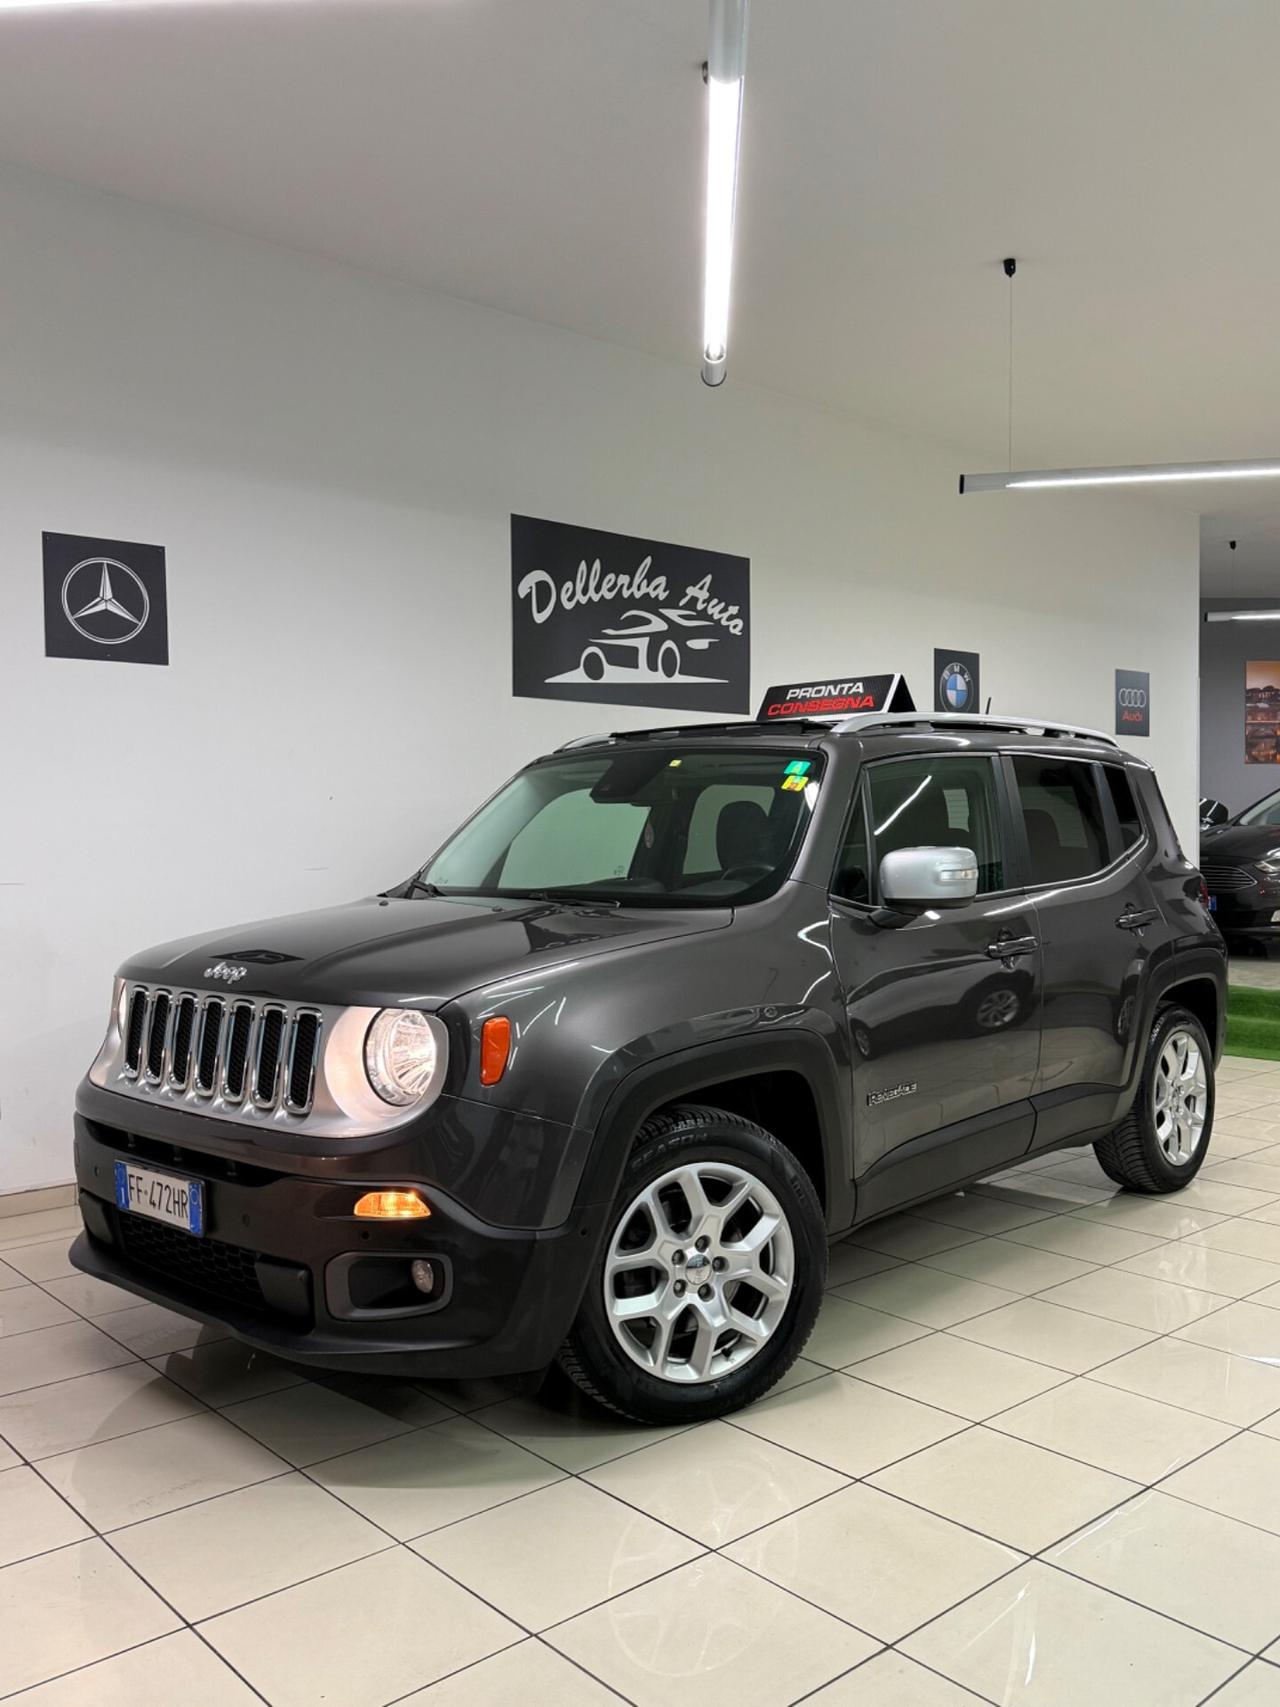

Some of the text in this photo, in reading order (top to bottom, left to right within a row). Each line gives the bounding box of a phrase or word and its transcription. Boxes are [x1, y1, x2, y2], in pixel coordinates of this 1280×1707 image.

[518, 556, 744, 635] Dellerba Auto
[786, 682, 864, 700] PRONTA
[767, 695, 875, 716] CONSEGNA
[203, 961, 247, 984] Jeep
